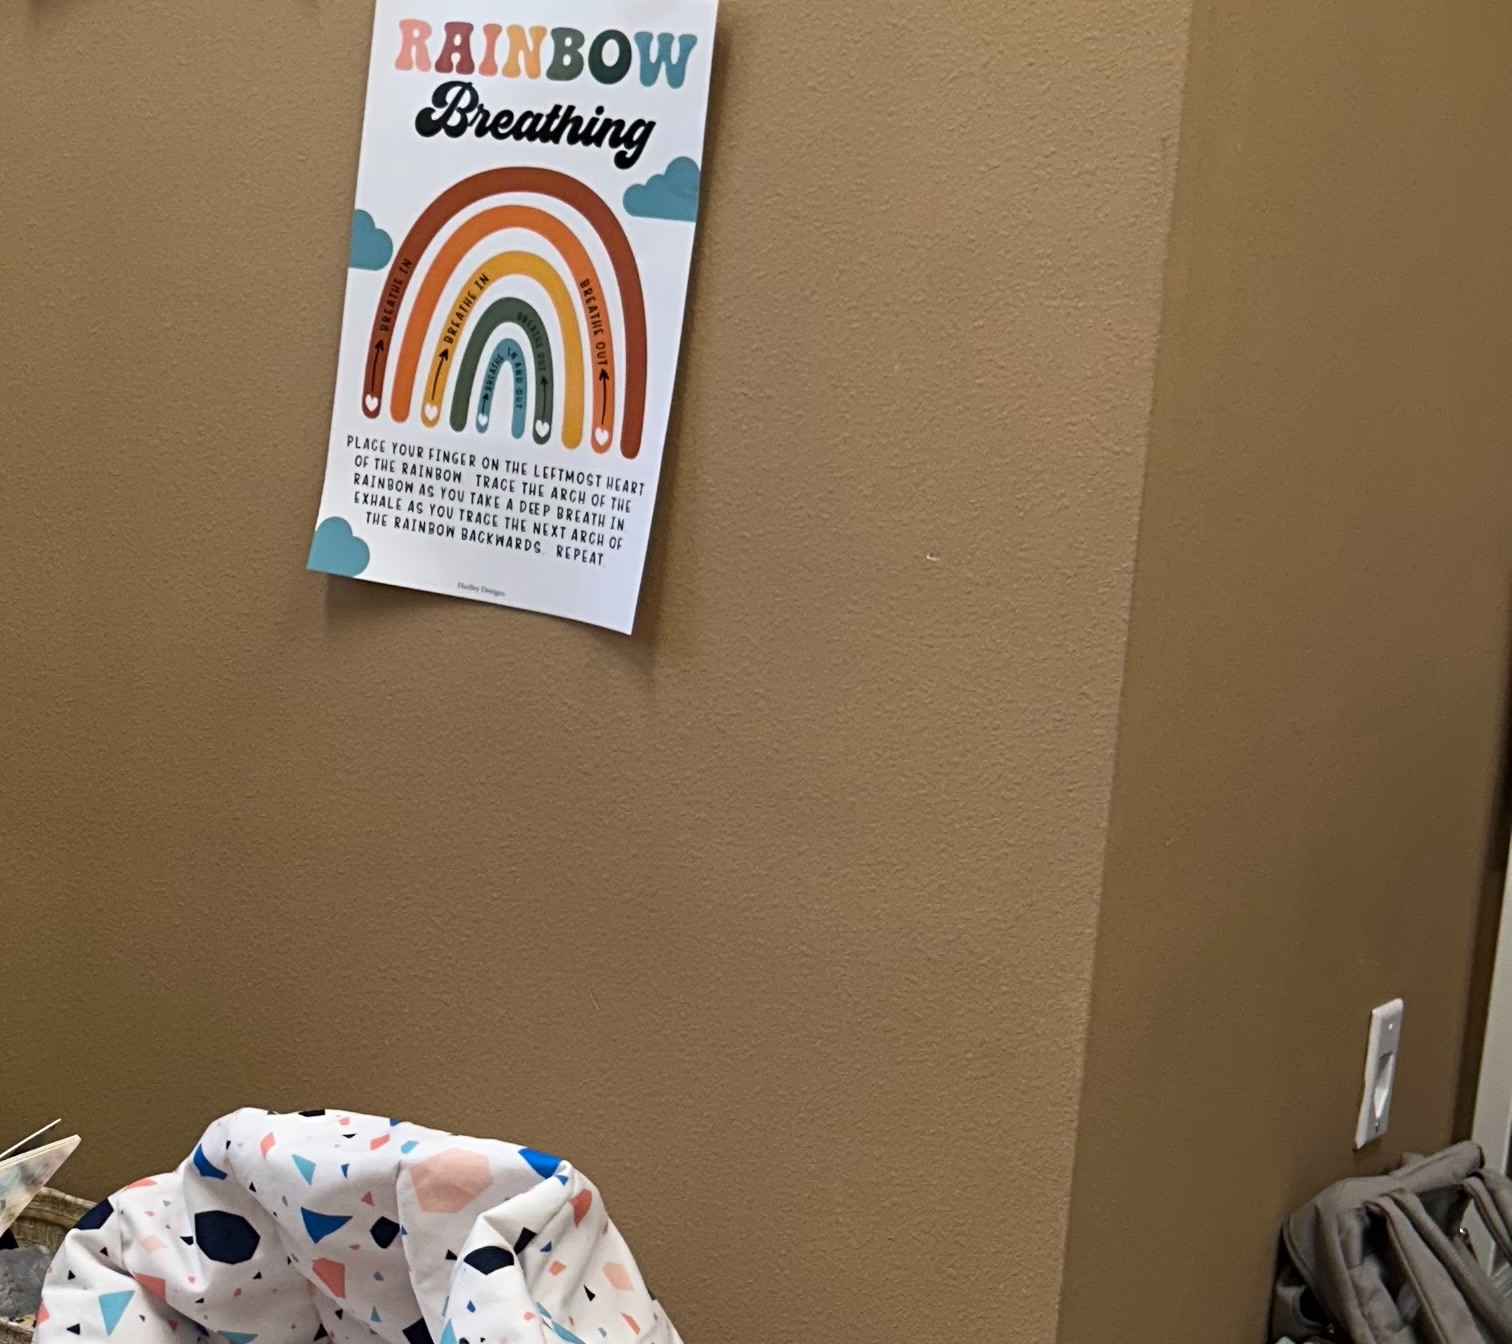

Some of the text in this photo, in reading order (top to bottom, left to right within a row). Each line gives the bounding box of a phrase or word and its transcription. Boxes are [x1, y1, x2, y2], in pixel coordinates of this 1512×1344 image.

[394, 18, 698, 89] RAINBOW
[415, 80, 656, 170] Breathing
[380, 258, 412, 332] BREATHE IN
[443, 273, 489, 344] BREATHE IN
[580, 278, 608, 366] BREATHE OUT
[515, 362, 523, 384] AND
[347, 435, 645, 496] PLACE YOUR FINGER ON THE LEFTMOST HEART
[355, 455, 369, 468] OF
[375, 458, 395, 473] THE
[476, 474, 515, 492] TRACE
[522, 482, 544, 497] THE
[551, 487, 586, 504] ARCH
[591, 494, 606, 507] OF
[611, 497, 632, 513] THE
[354, 473, 413, 493] RAINBOW
[419, 484, 434, 497] AS
[441, 487, 465, 502] YOU
[470, 492, 500, 509] TAKE
[506, 498, 513, 510] A
[520, 500, 550, 517] DEEP
[557, 506, 605, 528] BREATH
[354, 491, 623, 550] EXHALE AS YOU TRACE THE NEXT ARCH OF
[366, 512, 388, 526] THE
[394, 516, 455, 538] RAINBOW
